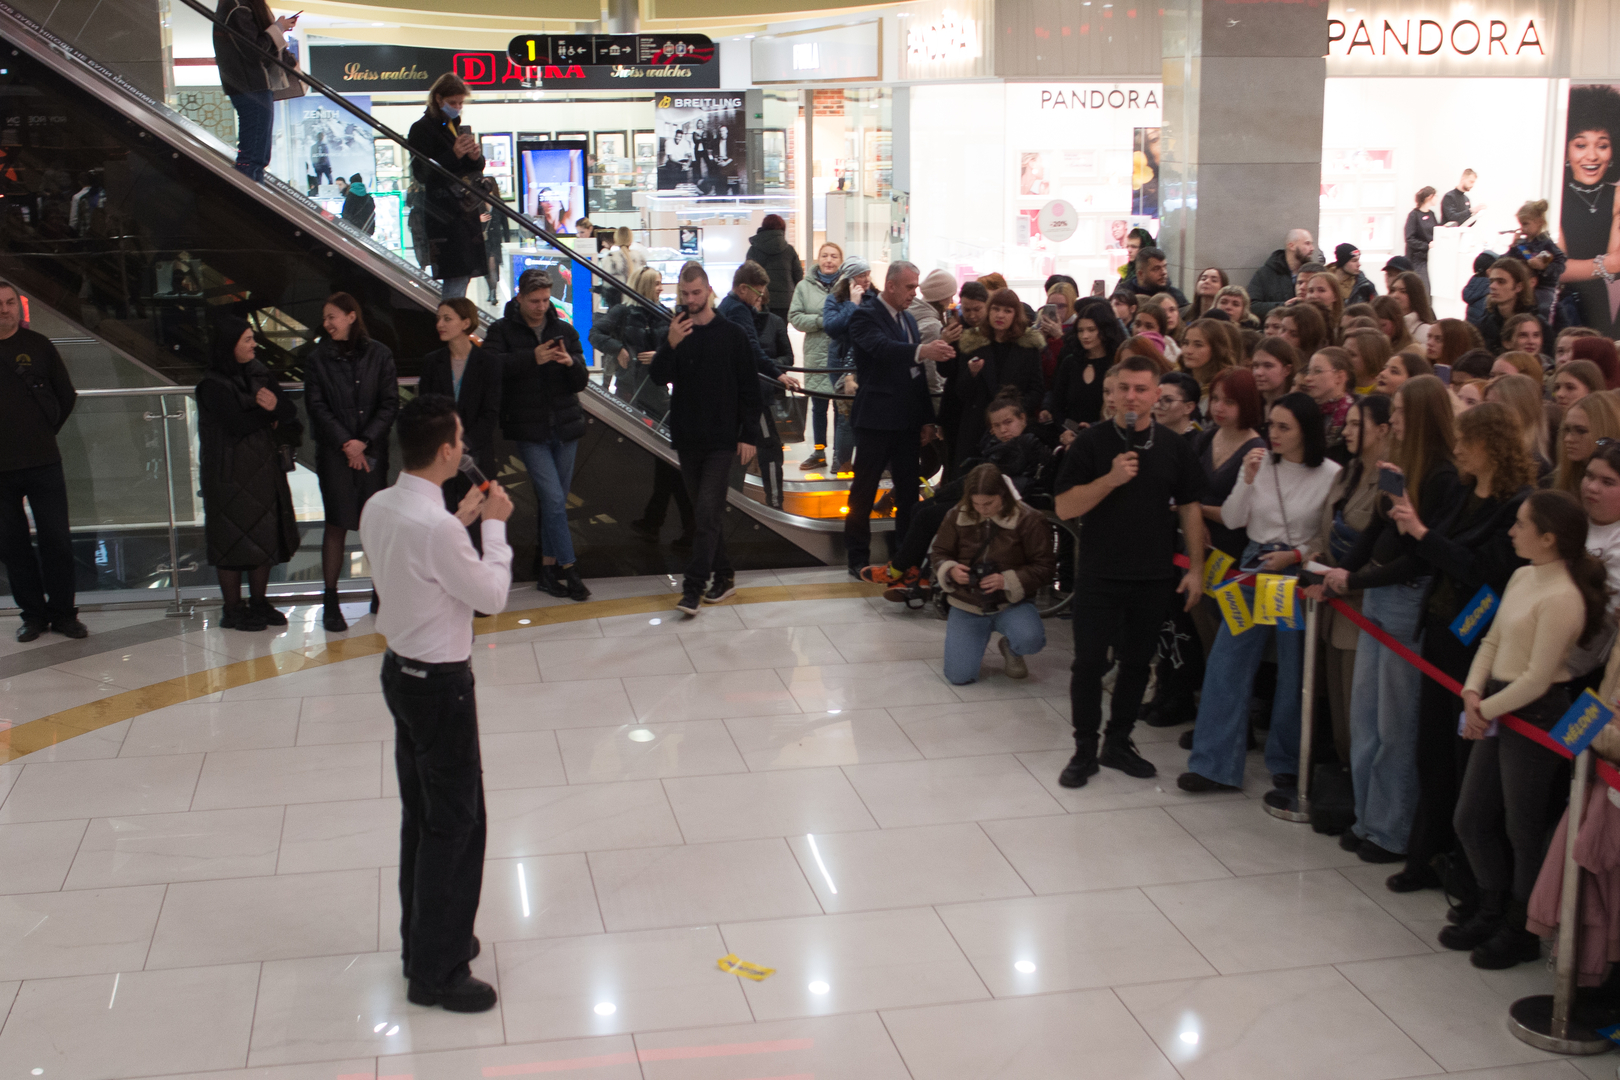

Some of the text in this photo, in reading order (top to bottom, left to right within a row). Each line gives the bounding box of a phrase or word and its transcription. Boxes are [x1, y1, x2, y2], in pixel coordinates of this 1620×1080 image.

[1327, 19, 1545, 55] PANDORA
[526, 40, 536, 61] 1
[343, 62, 429, 81] Swiss watches
[610, 64, 692, 78] Swiss watches
[112, 76, 157, 106] КРИВИМИ
[1041, 88, 1160, 109] PANDORA
[674, 98, 743, 108] BREITLING
[303, 110, 340, 119] ZENITH
[263, 172, 318, 210] НЕ КРОВИЛИ
[338, 221, 360, 238] ЩОБ
[427, 279, 443, 291] ДІТ
